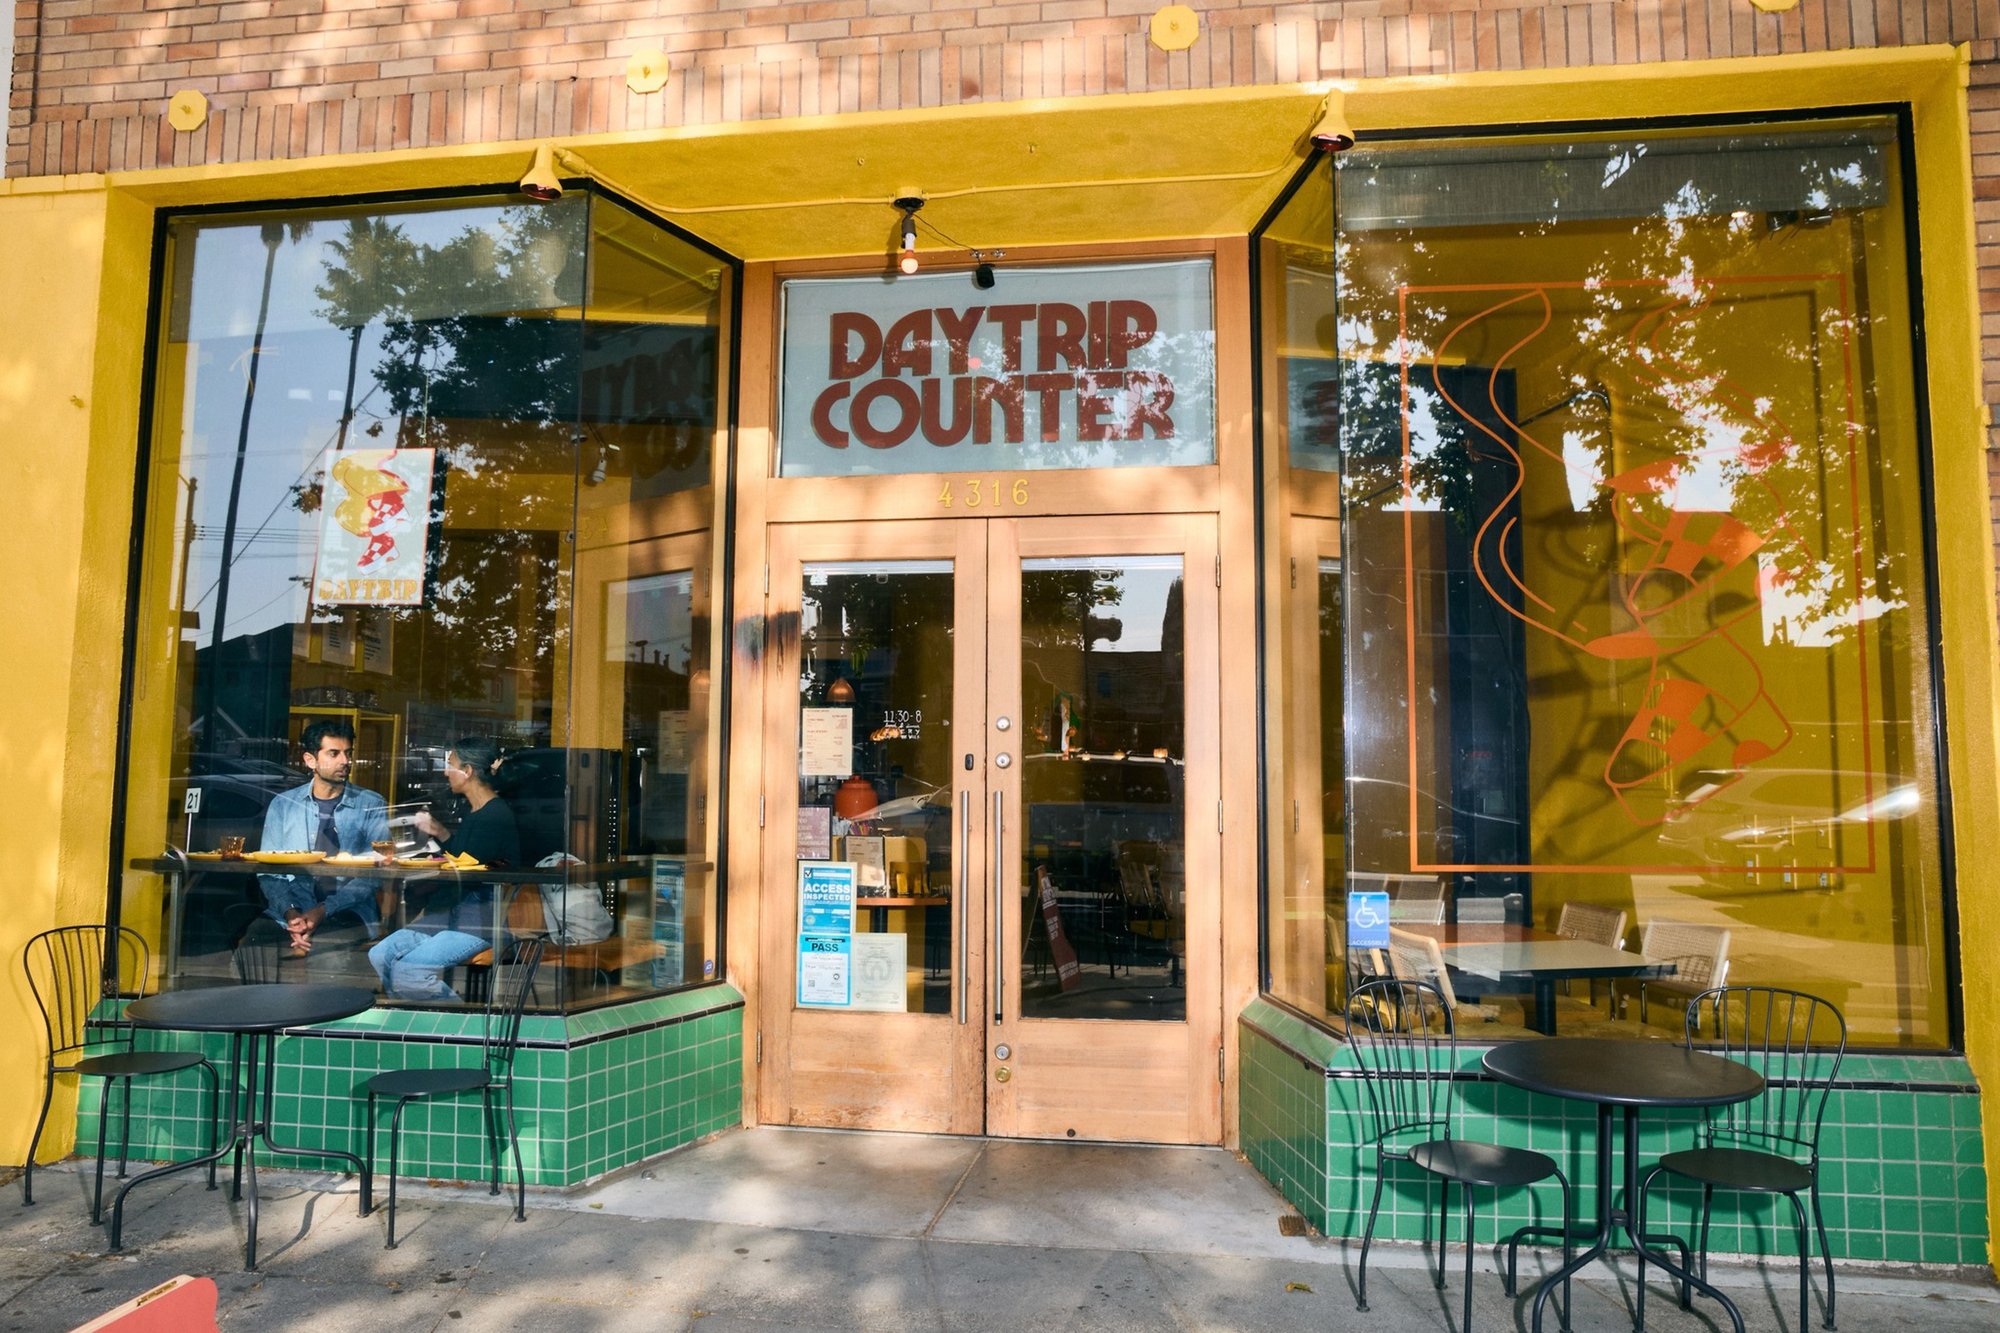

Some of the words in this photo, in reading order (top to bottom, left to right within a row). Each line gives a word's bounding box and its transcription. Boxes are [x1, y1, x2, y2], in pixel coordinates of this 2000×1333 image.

[829, 300, 1158, 380] DAYTRIP
[811, 371, 1175, 449] COUNTER
[937, 479, 1029, 508] 4316
[319, 579, 417, 600] DAYTRIP
[187, 793, 199, 809] 21
[803, 893, 850, 901] INSPECTED
[804, 883, 850, 894] ACCESS
[811, 942, 839, 952] PASS
